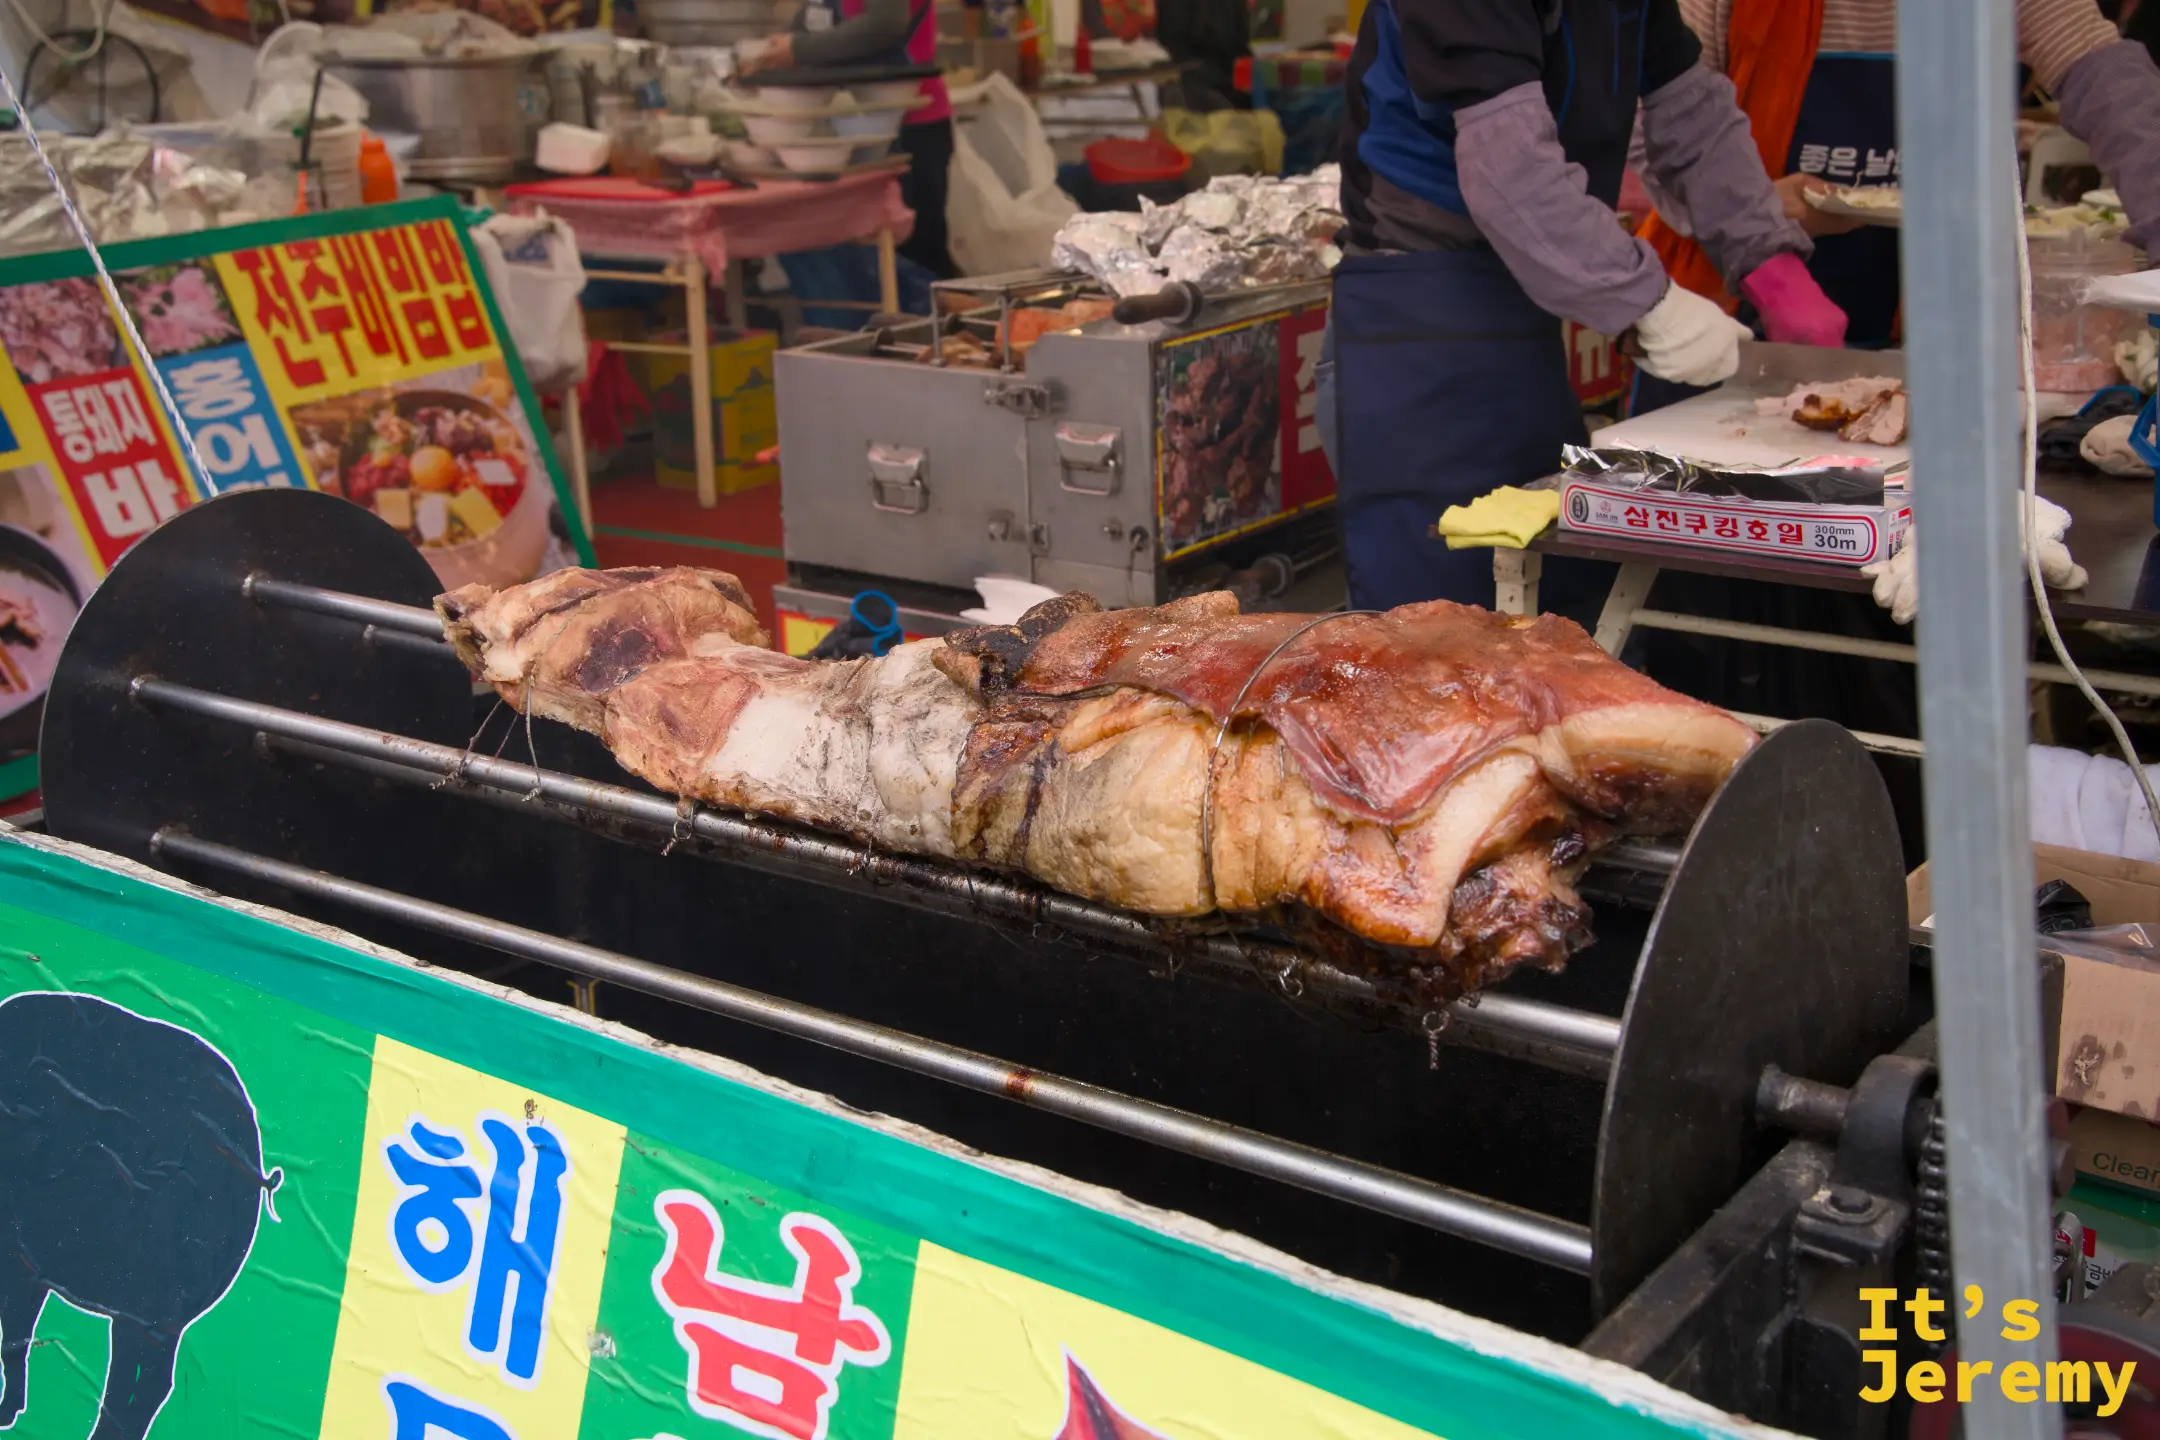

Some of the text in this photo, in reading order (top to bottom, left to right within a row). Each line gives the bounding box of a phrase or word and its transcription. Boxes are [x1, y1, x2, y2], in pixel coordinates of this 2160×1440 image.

[41, 377, 157, 464] 통돼지
[168, 357, 292, 493] 홍어
[1814, 524, 1855, 536] 300mm
[1814, 534, 1857, 551] 30m
